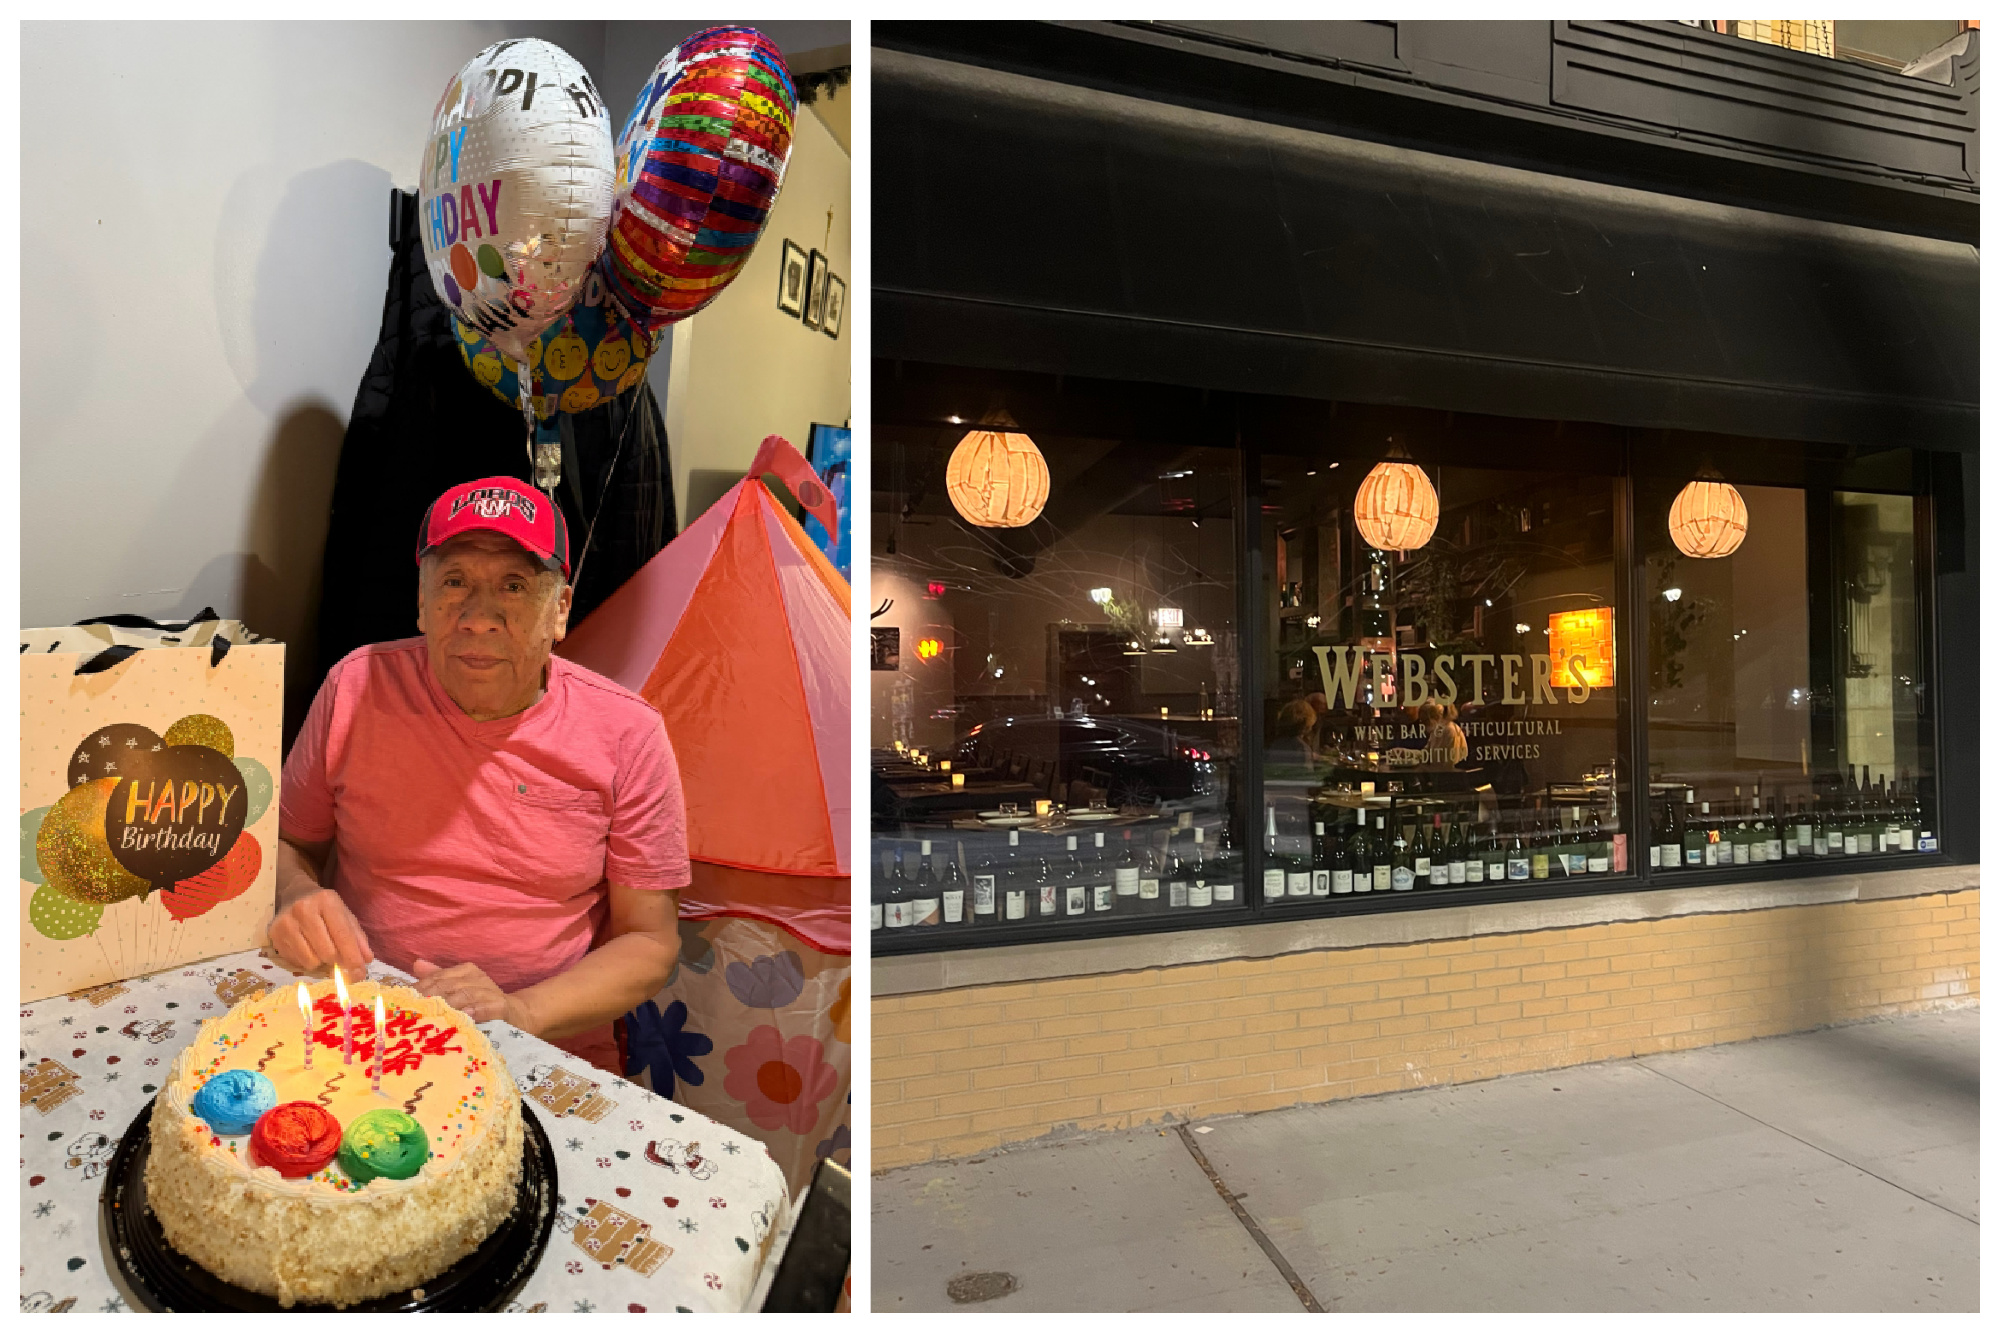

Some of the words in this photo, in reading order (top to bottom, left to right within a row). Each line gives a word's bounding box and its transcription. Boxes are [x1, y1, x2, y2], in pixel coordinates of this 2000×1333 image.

[1312, 645, 1591, 710] WEBSTER'S
[1354, 725, 1394, 741] WINE
[1401, 723, 1427, 739] BAR
[1433, 724, 1444, 738] &
[1385, 746, 1468, 766] EXPEDITION
[1476, 743, 1540, 761] SERVICES
[126, 778, 238, 825] HAPPY
[121, 825, 221, 856] Birthday
